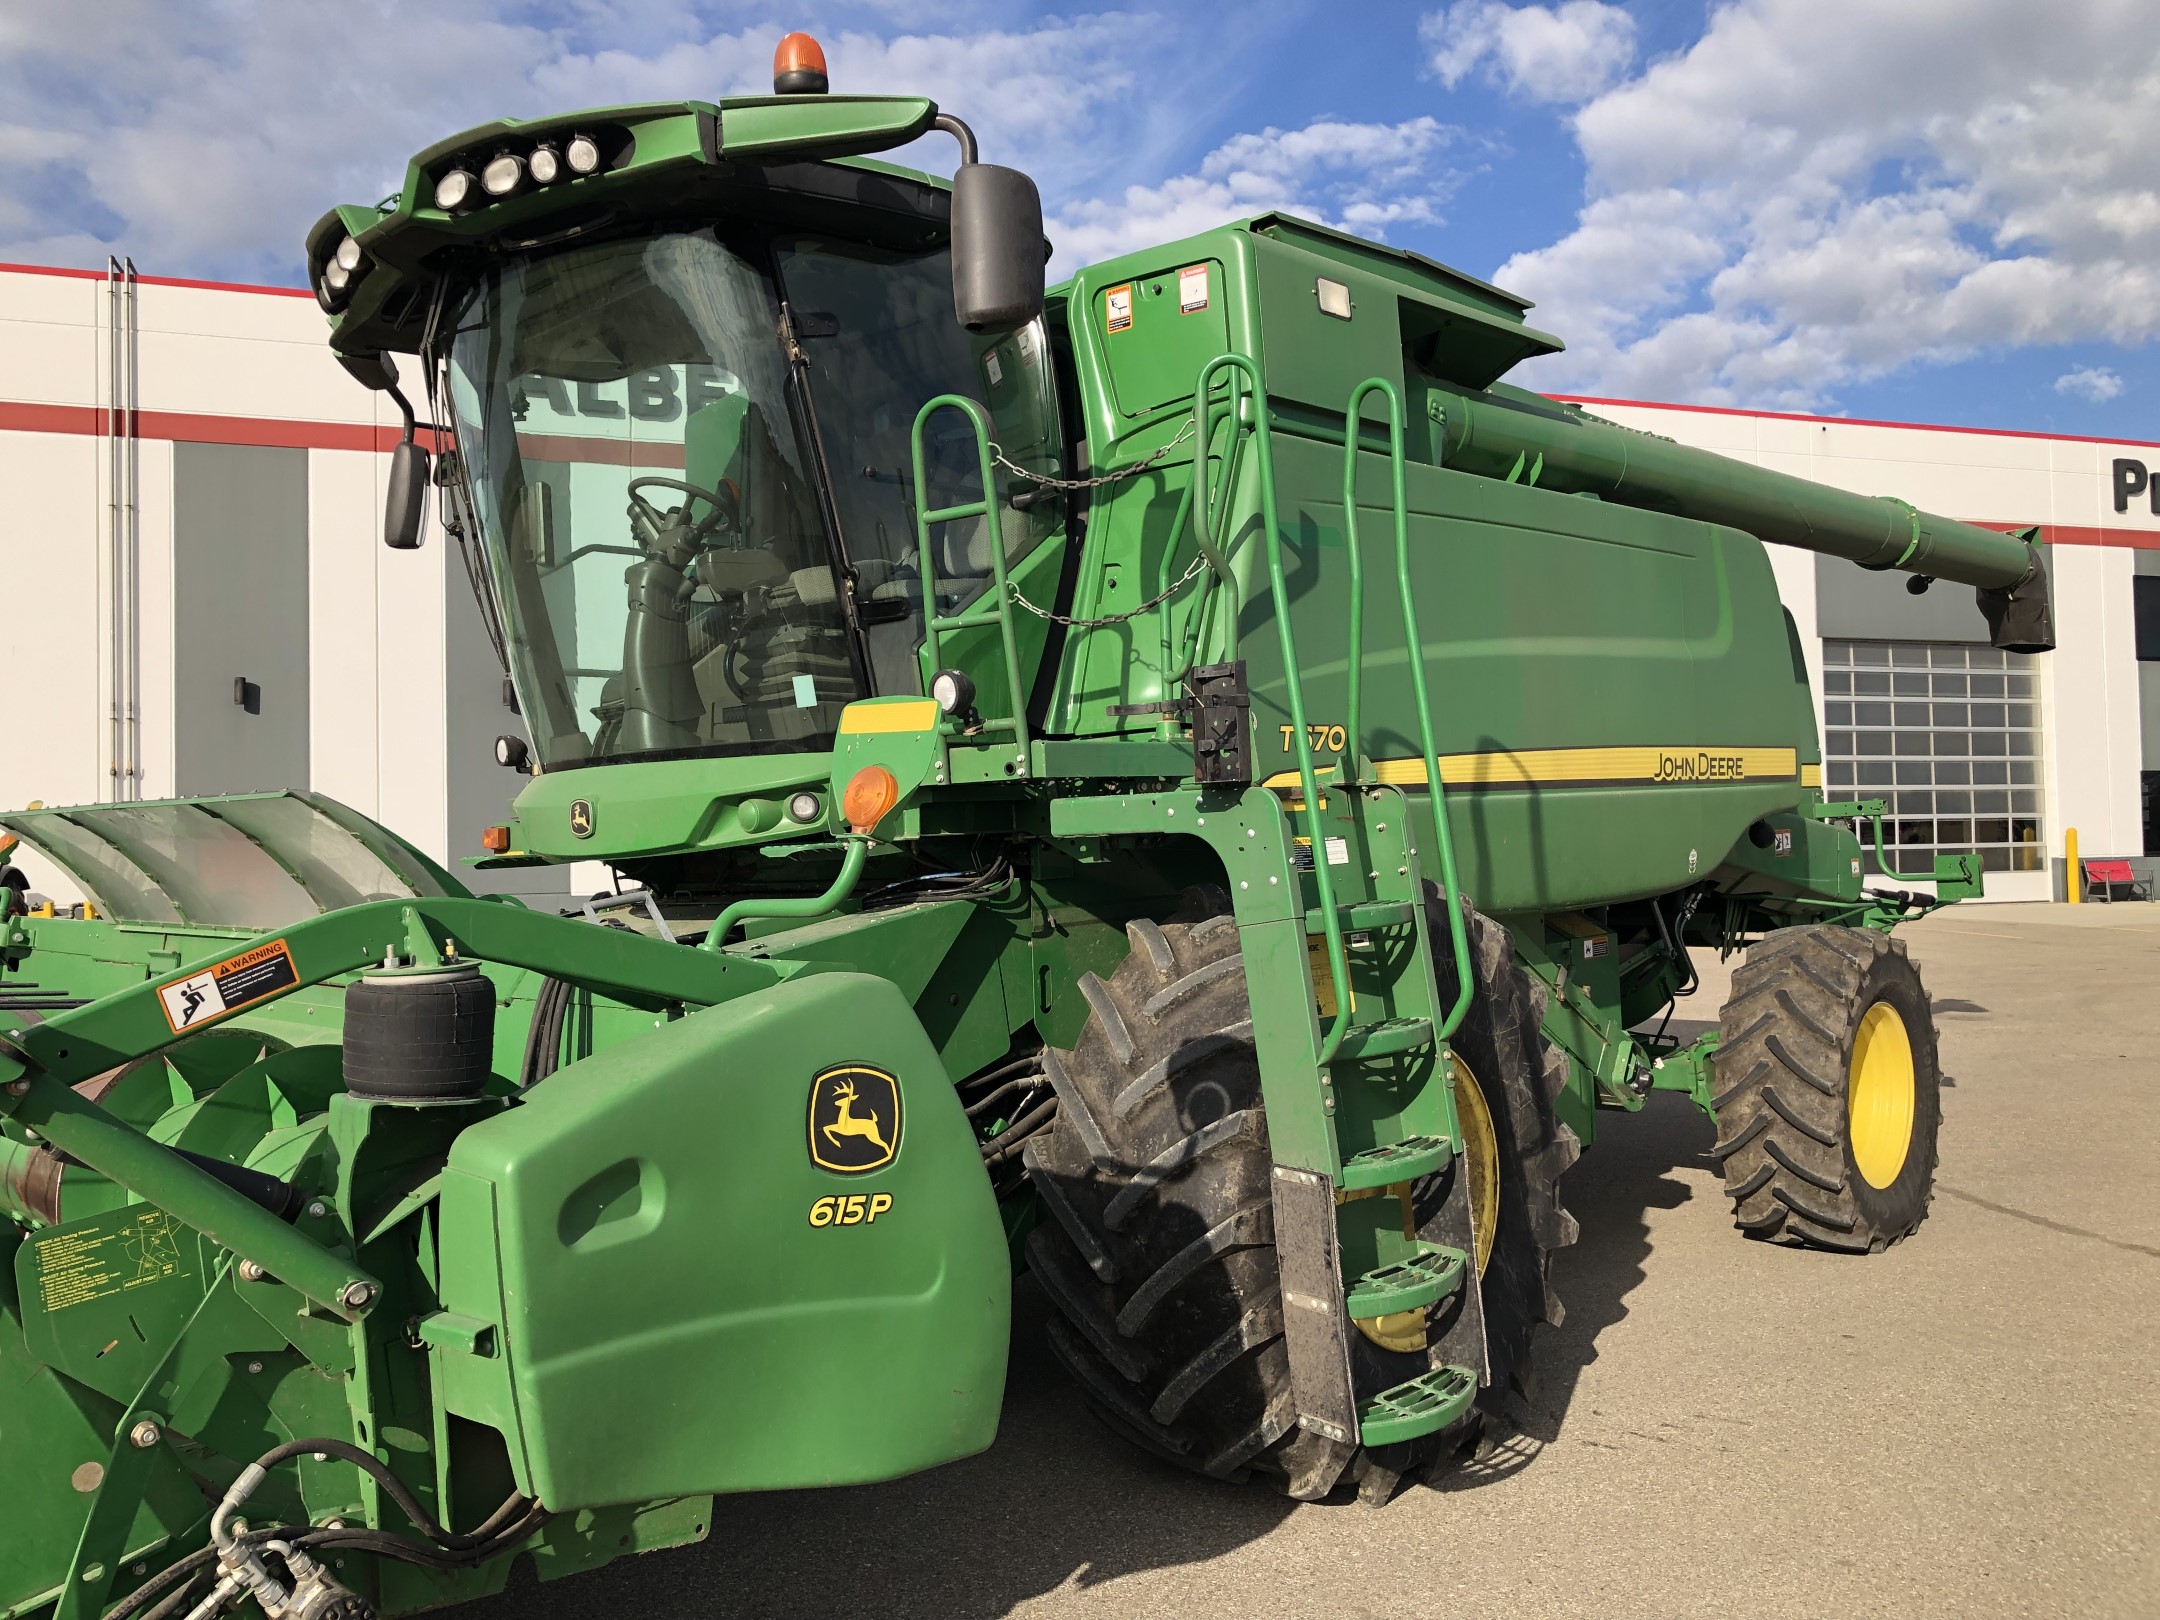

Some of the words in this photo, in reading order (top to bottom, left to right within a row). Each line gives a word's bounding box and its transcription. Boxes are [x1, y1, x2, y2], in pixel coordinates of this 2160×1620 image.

[1654, 752, 1695, 781] JOHN
[1698, 752, 1744, 779] DEERE
[230, 943, 282, 969] WARNING
[808, 1191, 894, 1229] 615P
